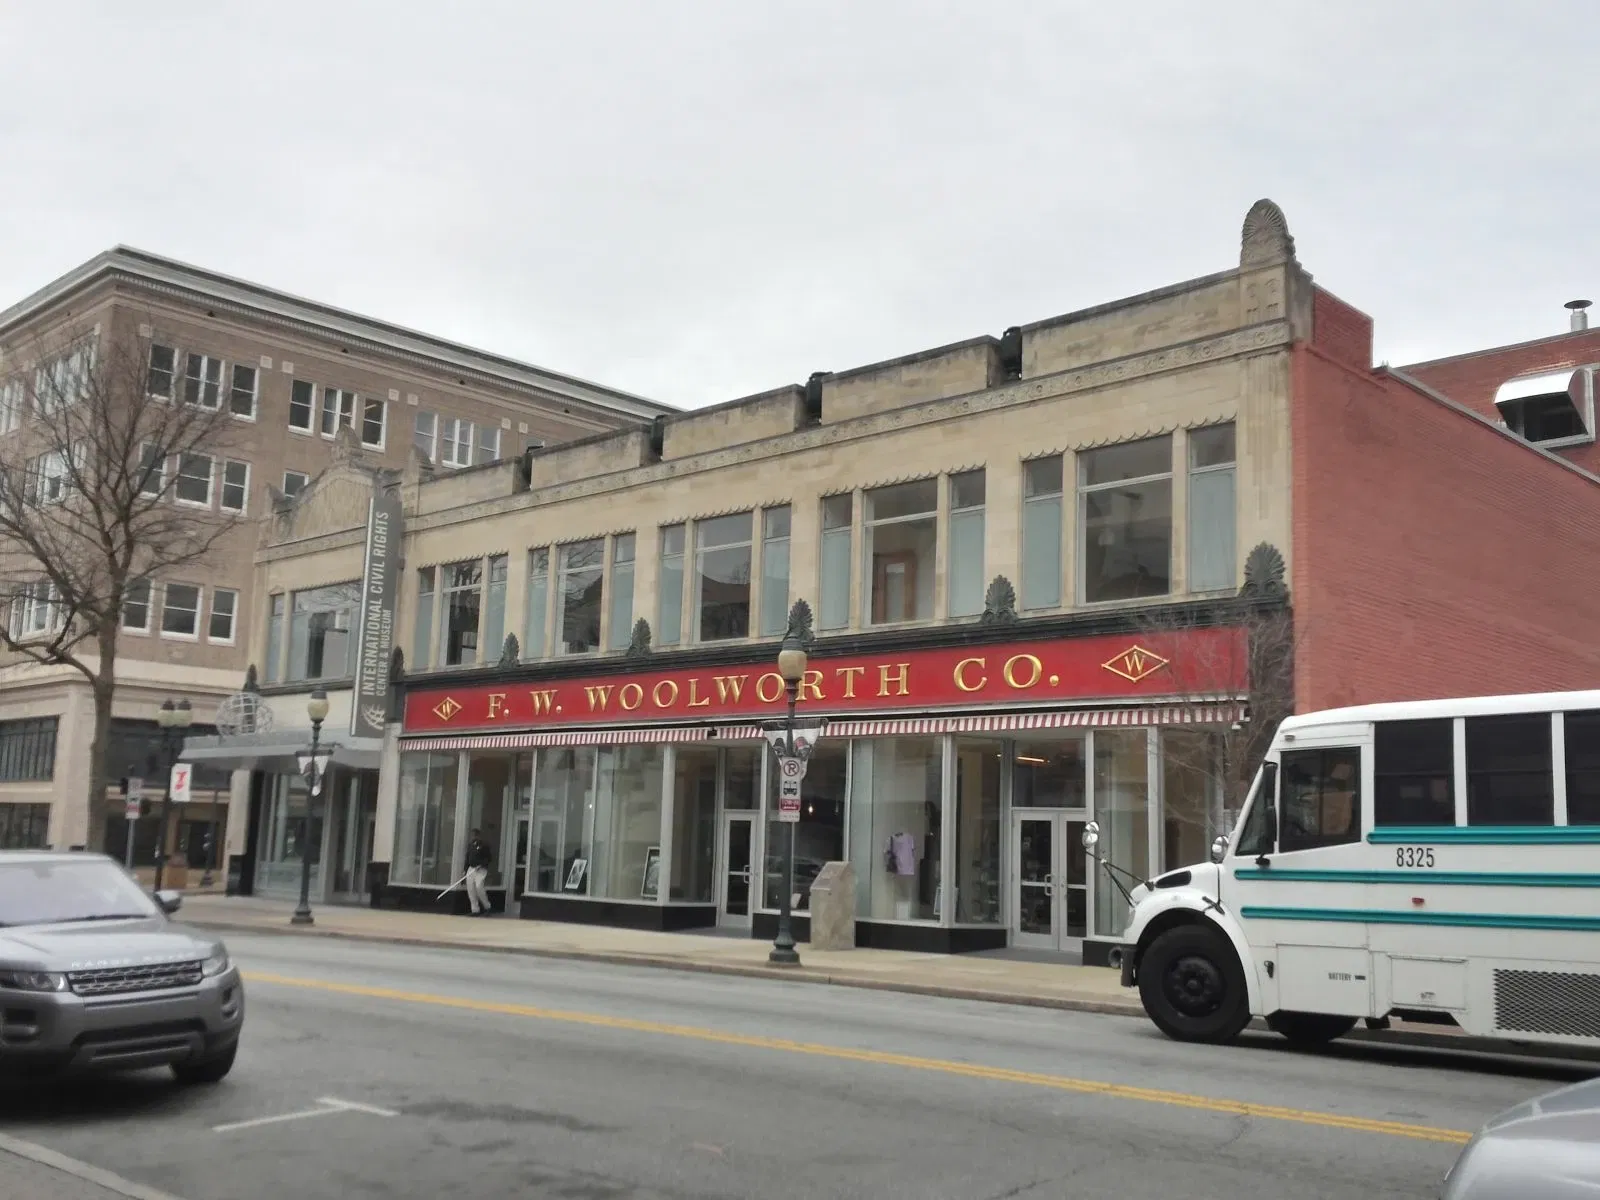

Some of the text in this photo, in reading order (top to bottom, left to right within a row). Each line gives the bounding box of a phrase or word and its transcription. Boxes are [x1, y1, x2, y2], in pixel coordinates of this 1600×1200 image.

[362, 511, 390, 696] INTERNATIONAL CIVIL RIGHTS
[381, 609, 392, 649] MUSEUM
[376, 660, 387, 696] CENTER
[1123, 652, 1147, 675] W
[486, 654, 1060, 719] F. W. WOOLWORTH CO.
[1396, 847, 1435, 868] 8325
[1328, 972, 1352, 981] BATTERY
